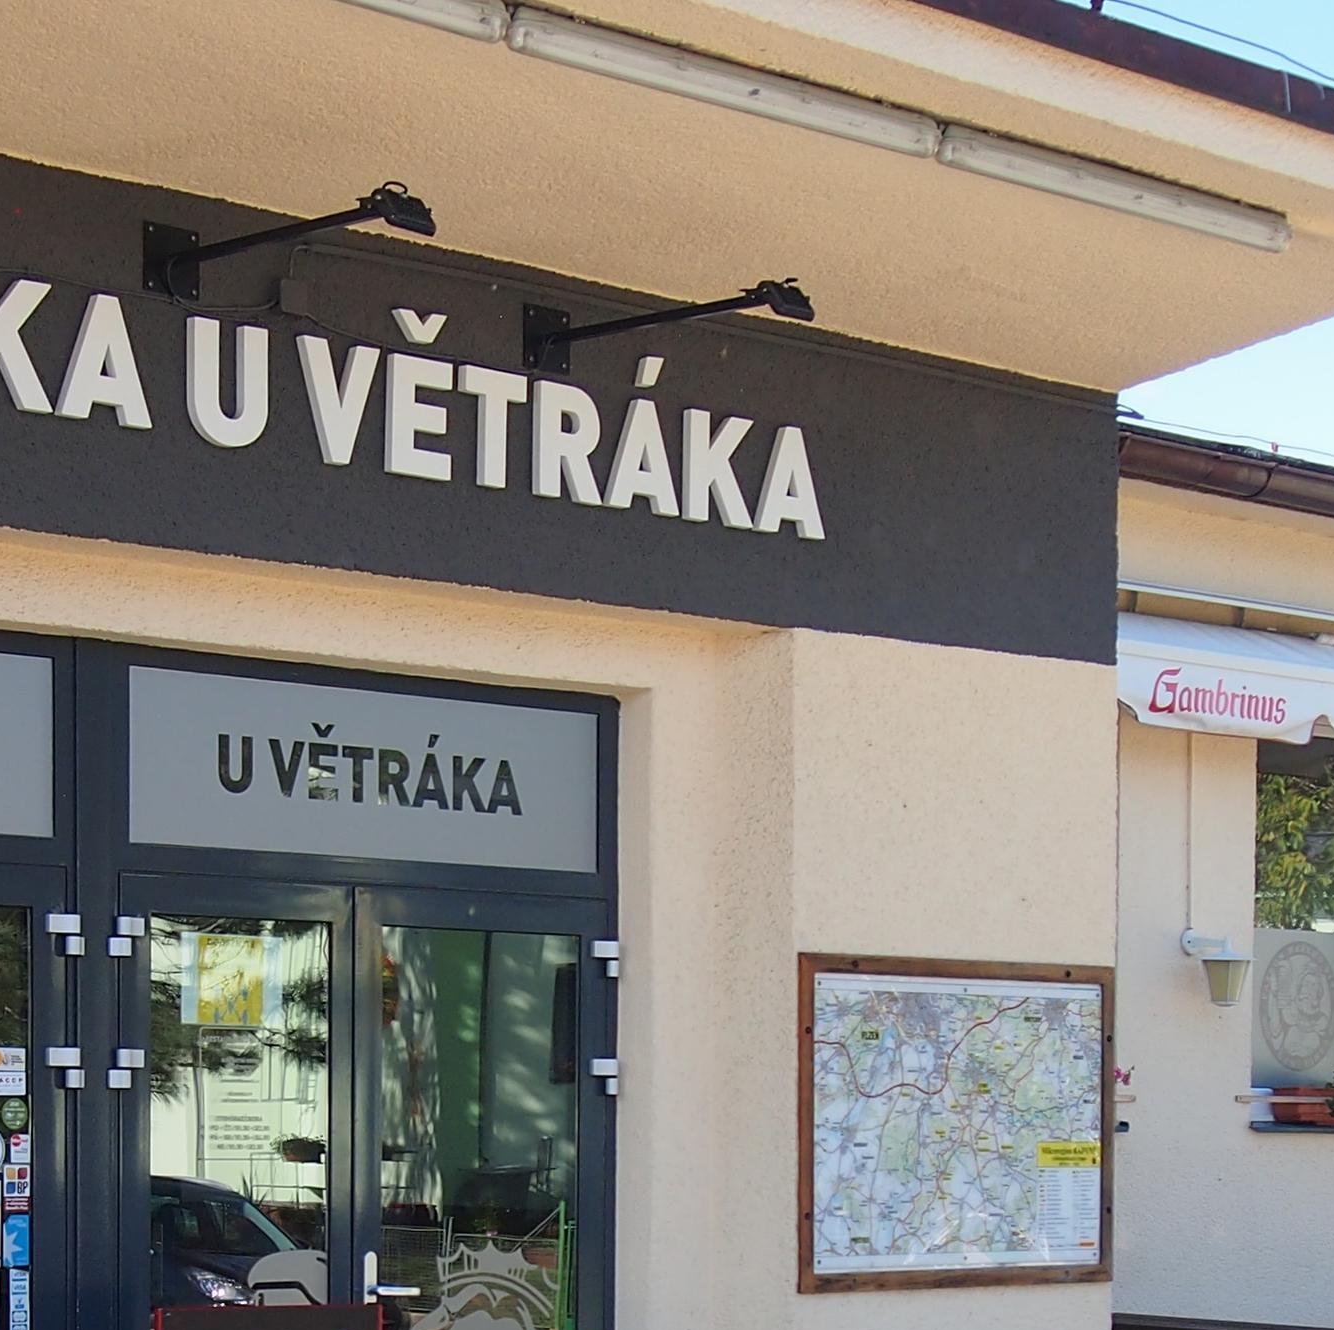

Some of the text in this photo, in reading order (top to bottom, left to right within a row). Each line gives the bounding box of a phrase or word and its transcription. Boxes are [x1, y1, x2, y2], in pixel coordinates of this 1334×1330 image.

[185, 316, 269, 448] U
[295, 307, 826, 541] VĚTRÁKA
[1148, 666, 1288, 726] Gambrinus
[217, 721, 523, 816] U VĚTRÁKA
